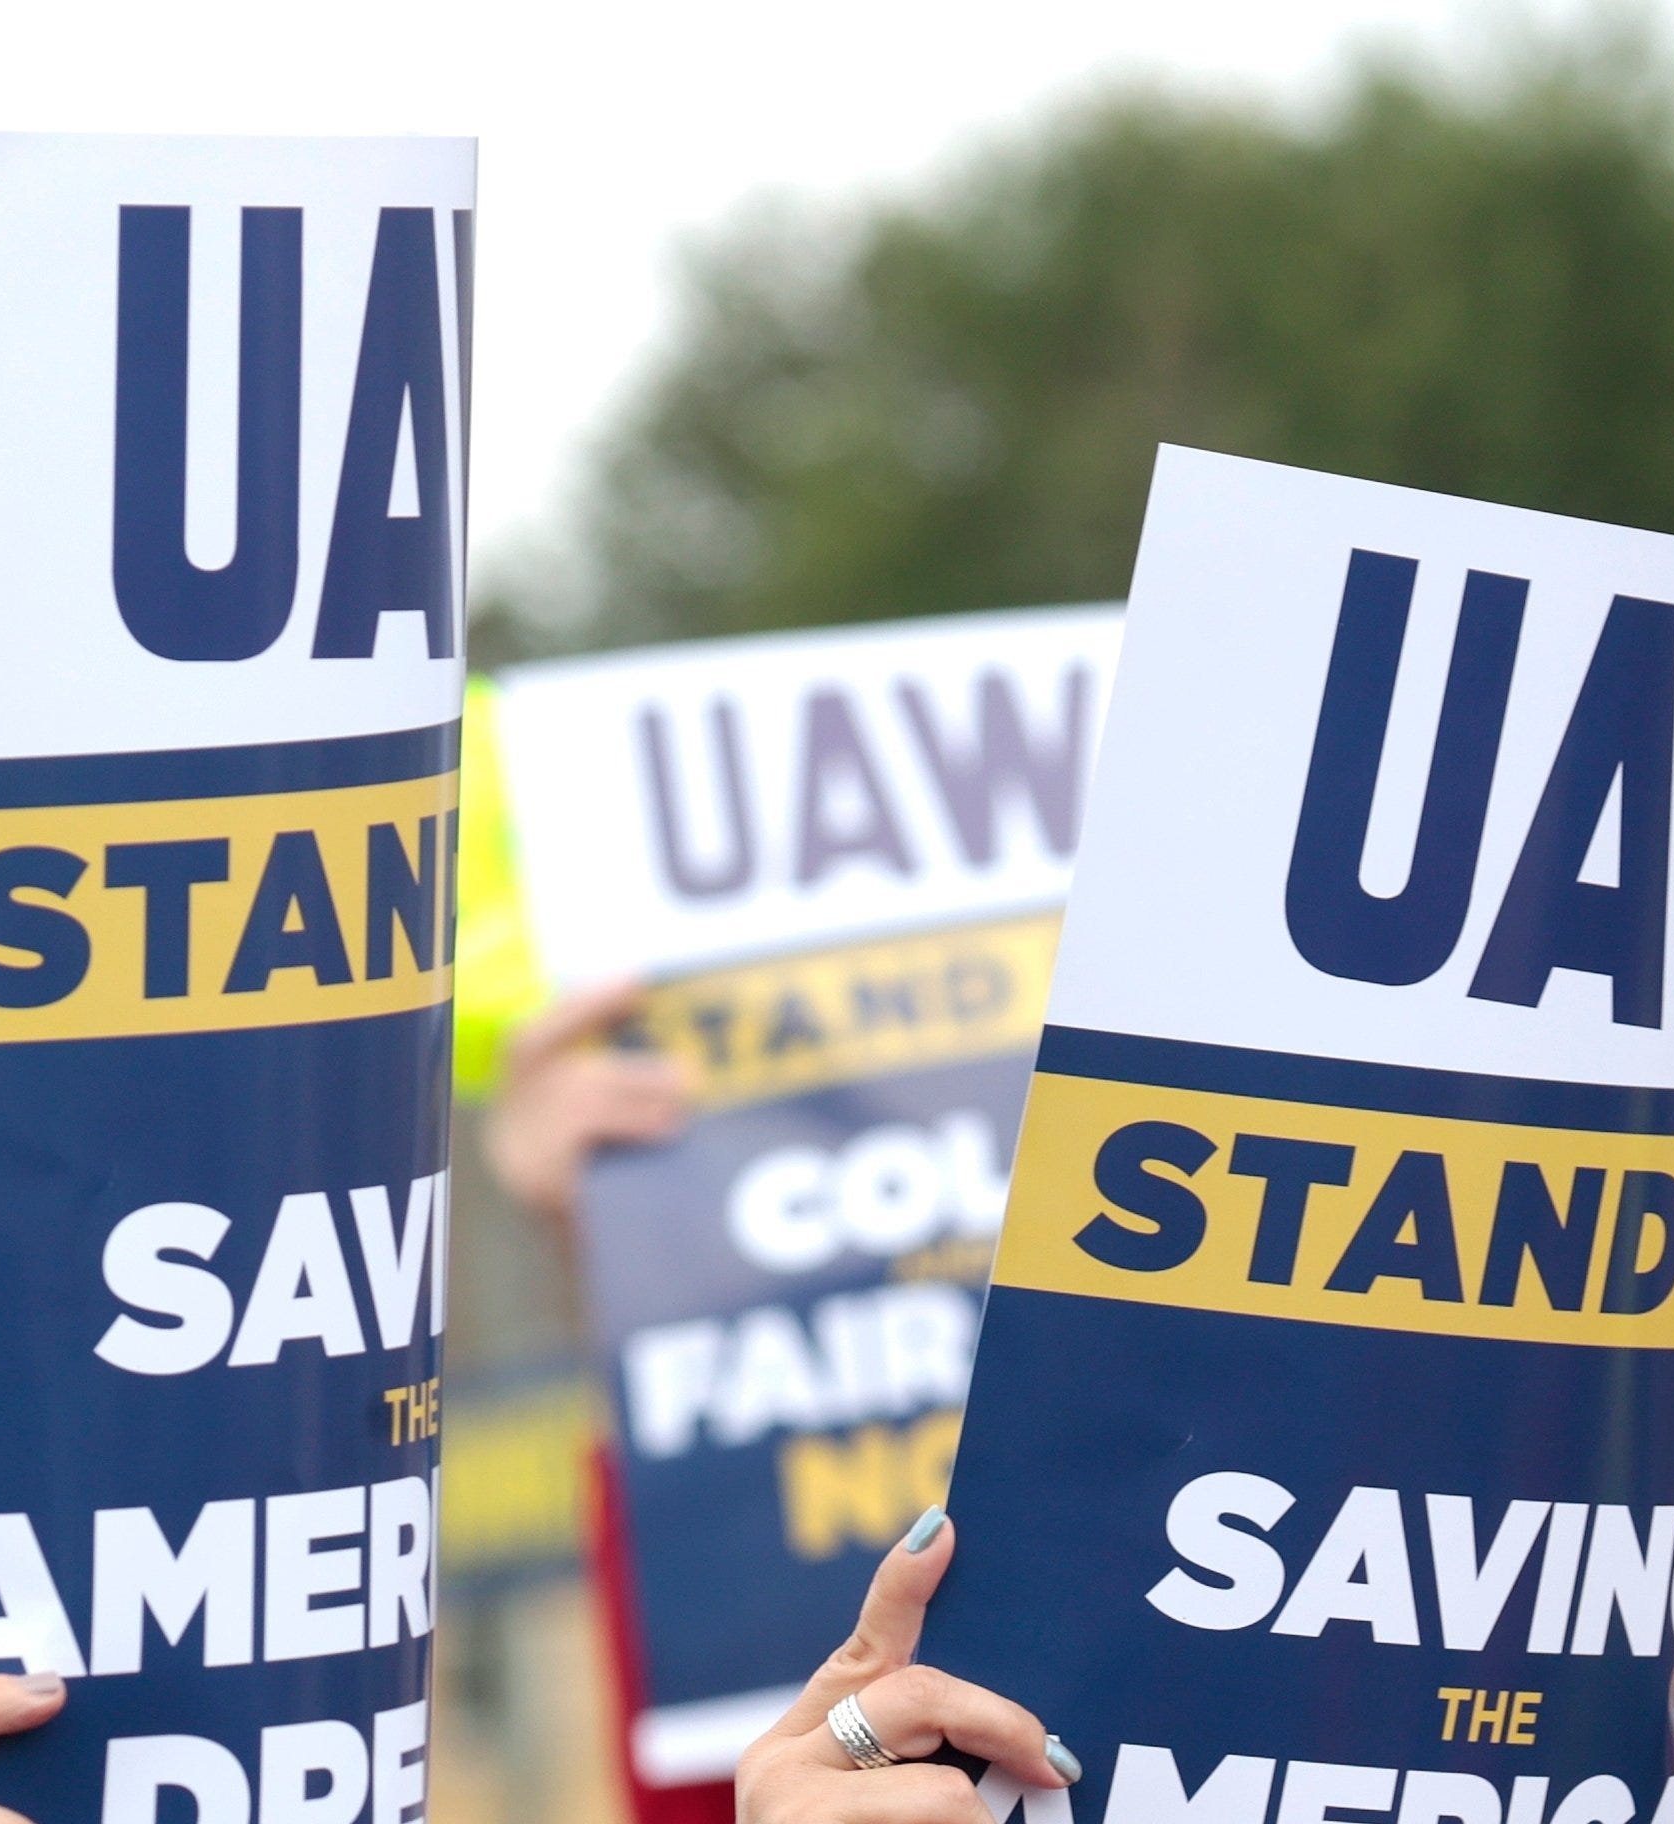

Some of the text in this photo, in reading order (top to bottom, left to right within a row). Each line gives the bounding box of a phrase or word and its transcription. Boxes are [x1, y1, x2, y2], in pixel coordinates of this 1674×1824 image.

[635, 664, 1093, 897] UAW
[383, 1377, 439, 1447] THE
[1437, 1686, 1544, 1746] THE
